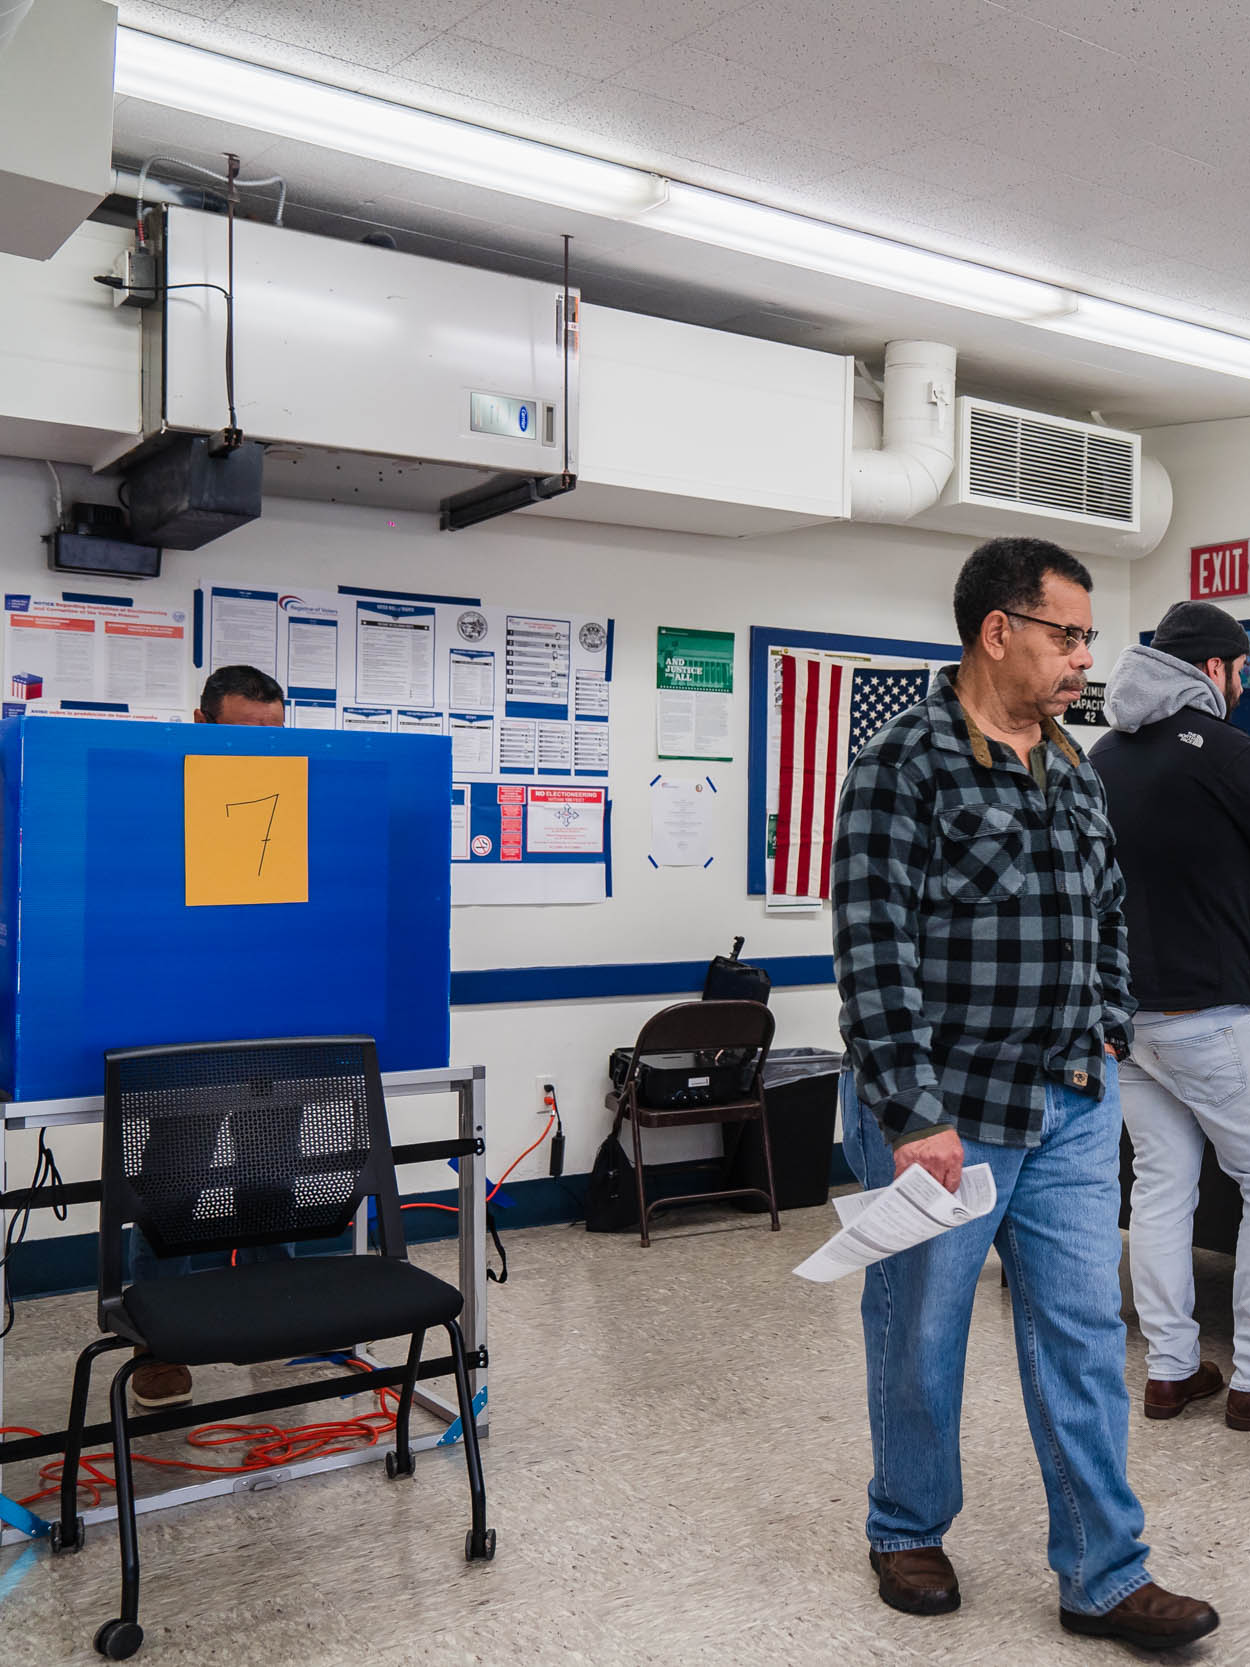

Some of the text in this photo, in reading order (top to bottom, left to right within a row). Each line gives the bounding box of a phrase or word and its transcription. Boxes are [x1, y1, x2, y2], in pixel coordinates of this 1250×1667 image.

[1200, 548, 1243, 594] EXIT
[665, 658, 685, 666] AND
[665, 666, 703, 675] JUSTICE
[1071, 698, 1104, 710] CAPACIT
[1085, 711, 1096, 723] 42
[226, 793, 280, 877] 7
